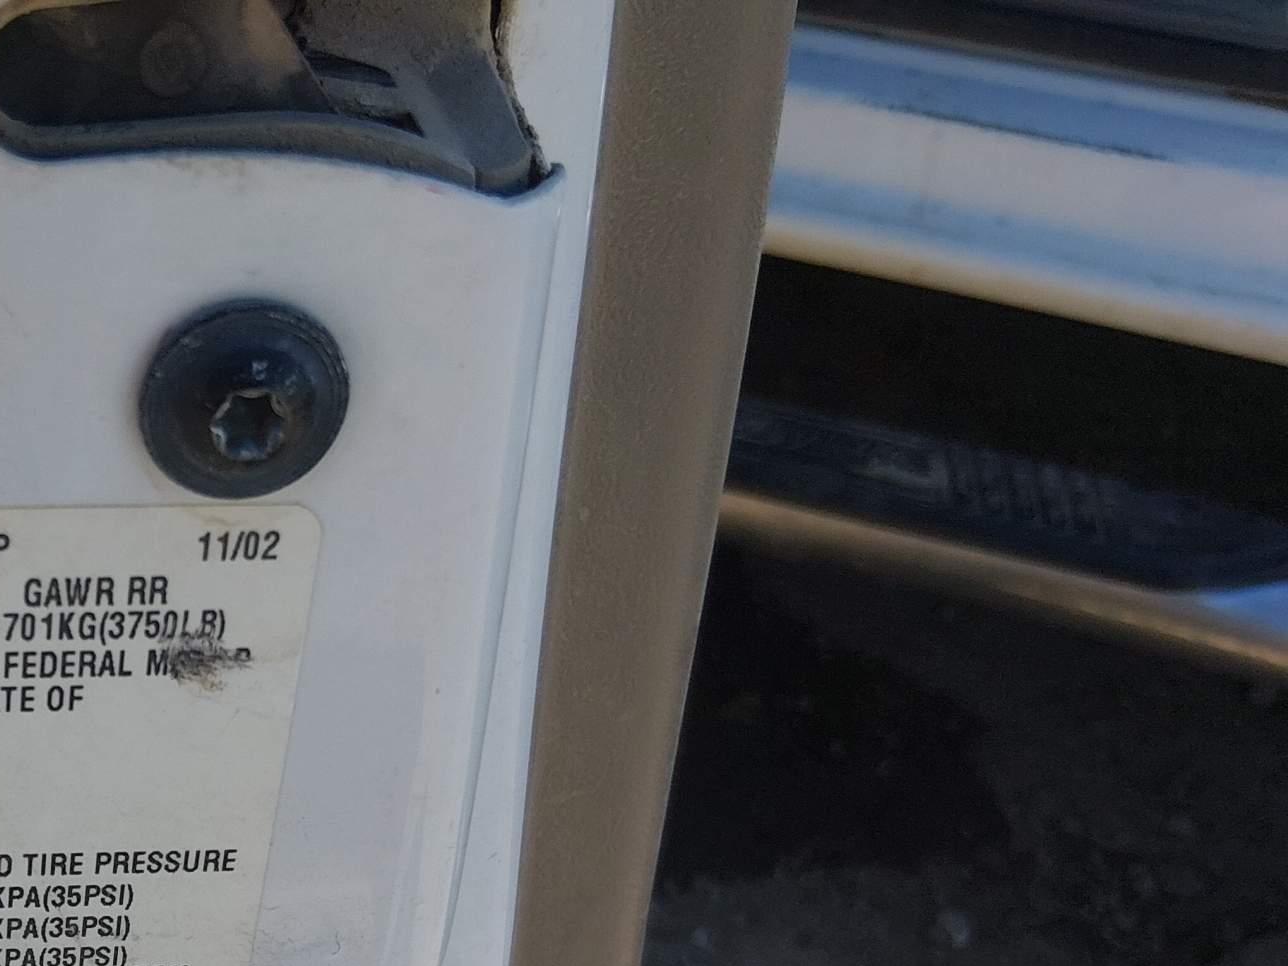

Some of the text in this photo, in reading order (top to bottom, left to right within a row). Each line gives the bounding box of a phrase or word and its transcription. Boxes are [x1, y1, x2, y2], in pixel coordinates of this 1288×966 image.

[199, 532, 280, 561] 11/02
[24, 577, 168, 607] GAWR RR
[4, 650, 132, 679] FEDERAL
[47, 685, 84, 712] OF
[23, 852, 84, 876] TIRE
[95, 849, 237, 873] PRESSURE
